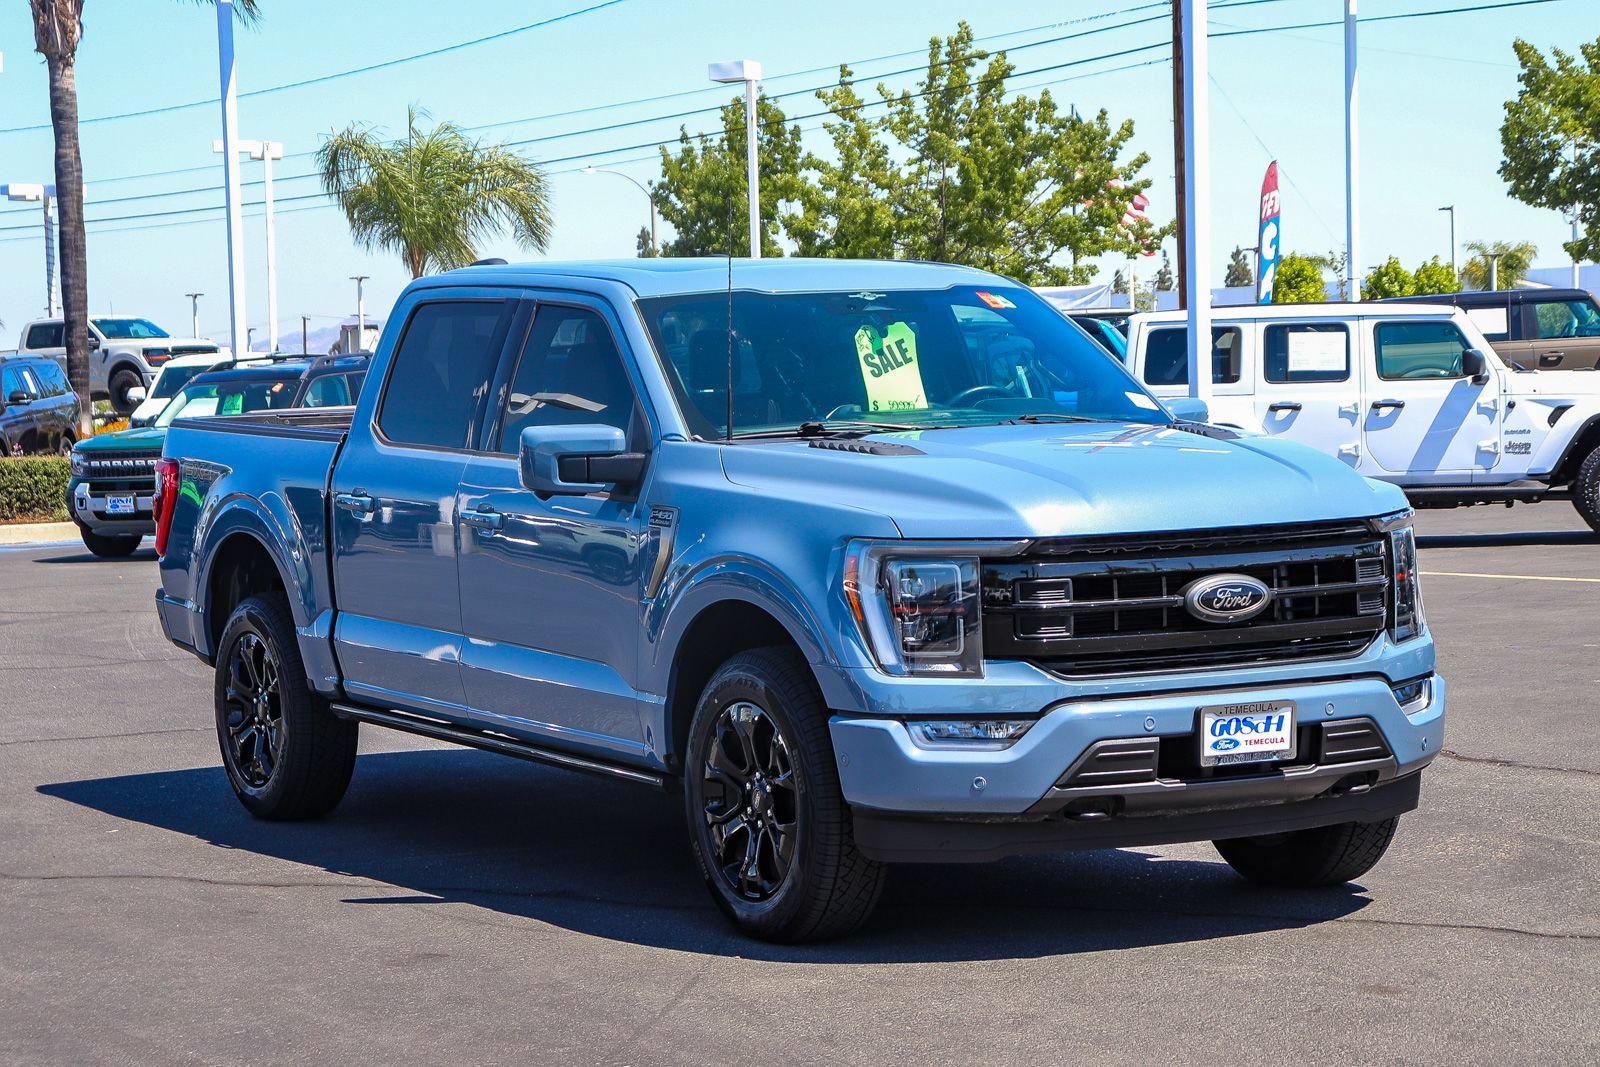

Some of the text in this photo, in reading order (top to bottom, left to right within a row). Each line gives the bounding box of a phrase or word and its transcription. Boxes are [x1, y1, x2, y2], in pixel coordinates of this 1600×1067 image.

[863, 338, 914, 378] SALE
[1213, 588, 1252, 609] Ford
[1224, 702, 1274, 715] TEMECULA
[1244, 736, 1285, 746] TEMECULA
